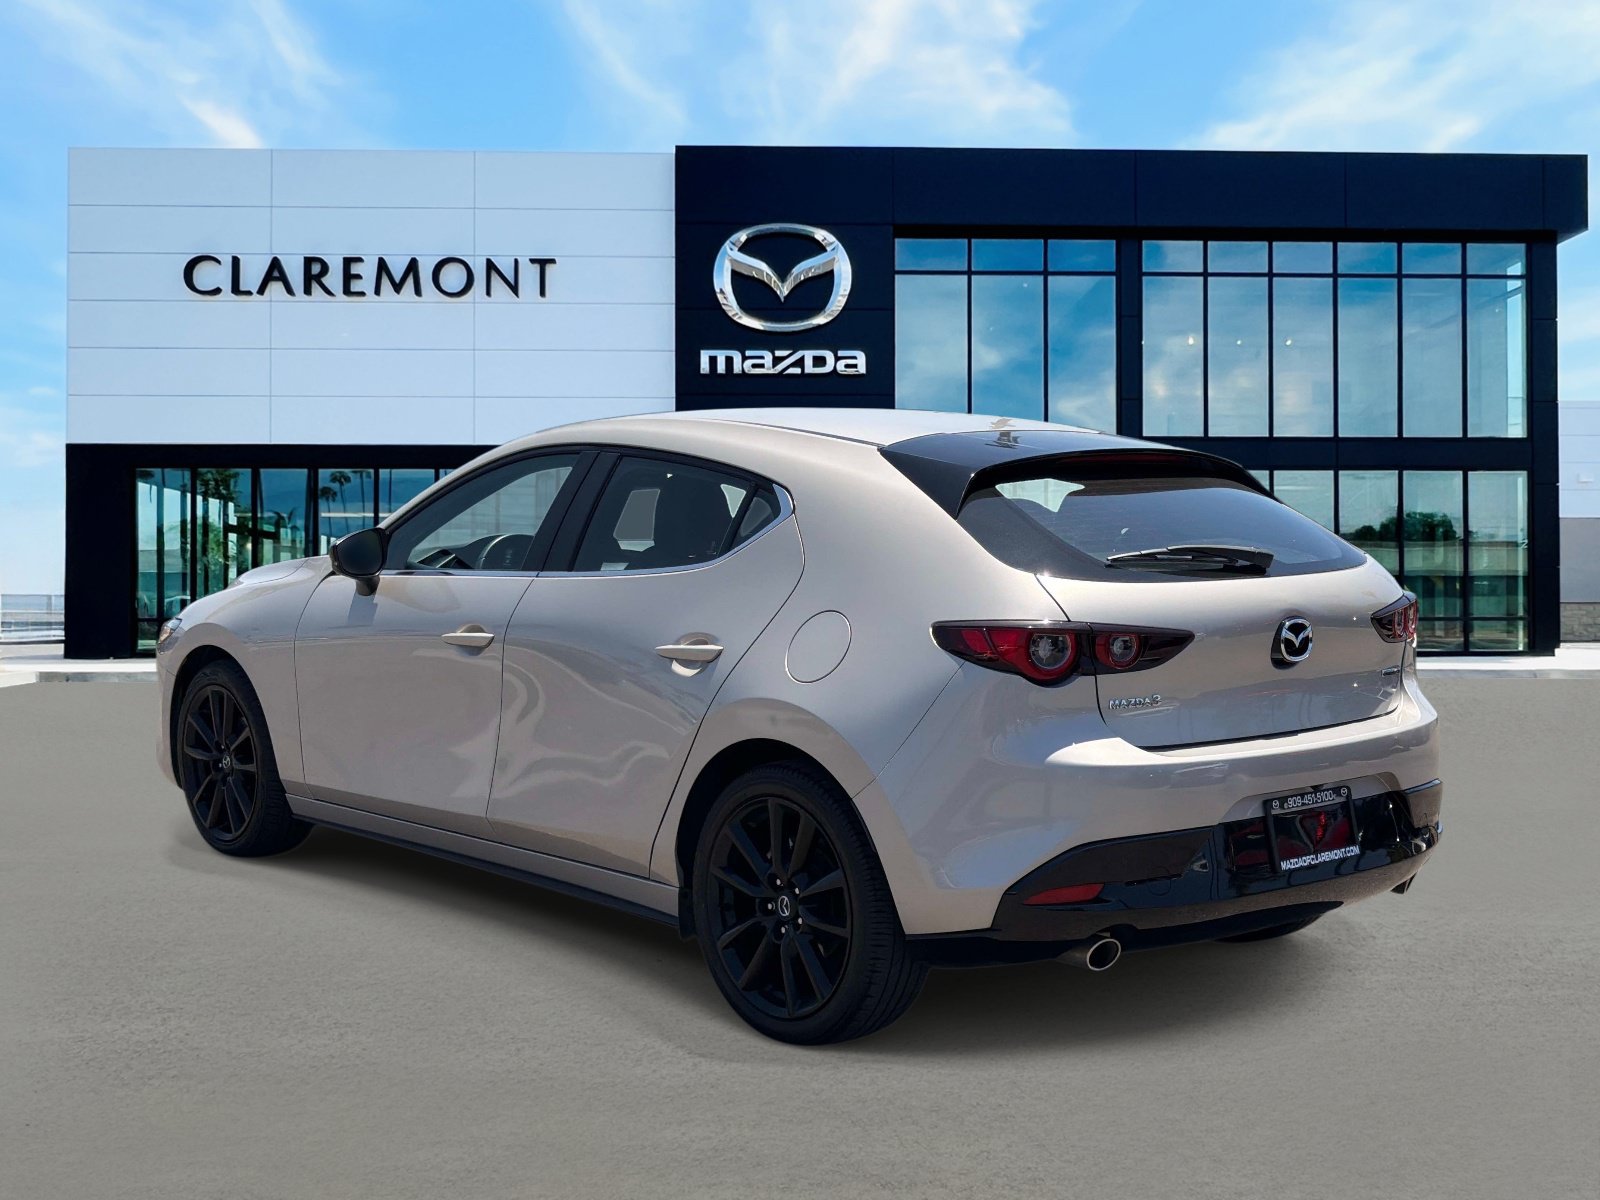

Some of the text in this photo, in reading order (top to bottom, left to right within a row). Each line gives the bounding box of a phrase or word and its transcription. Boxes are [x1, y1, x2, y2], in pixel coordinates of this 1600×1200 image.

[182, 254, 558, 299] CLAREMONT
[699, 349, 867, 375] mazda
[1287, 790, 1334, 808] 909-451-5100
[1280, 845, 1361, 871] MAZDAOFCLAREMONT.COM
